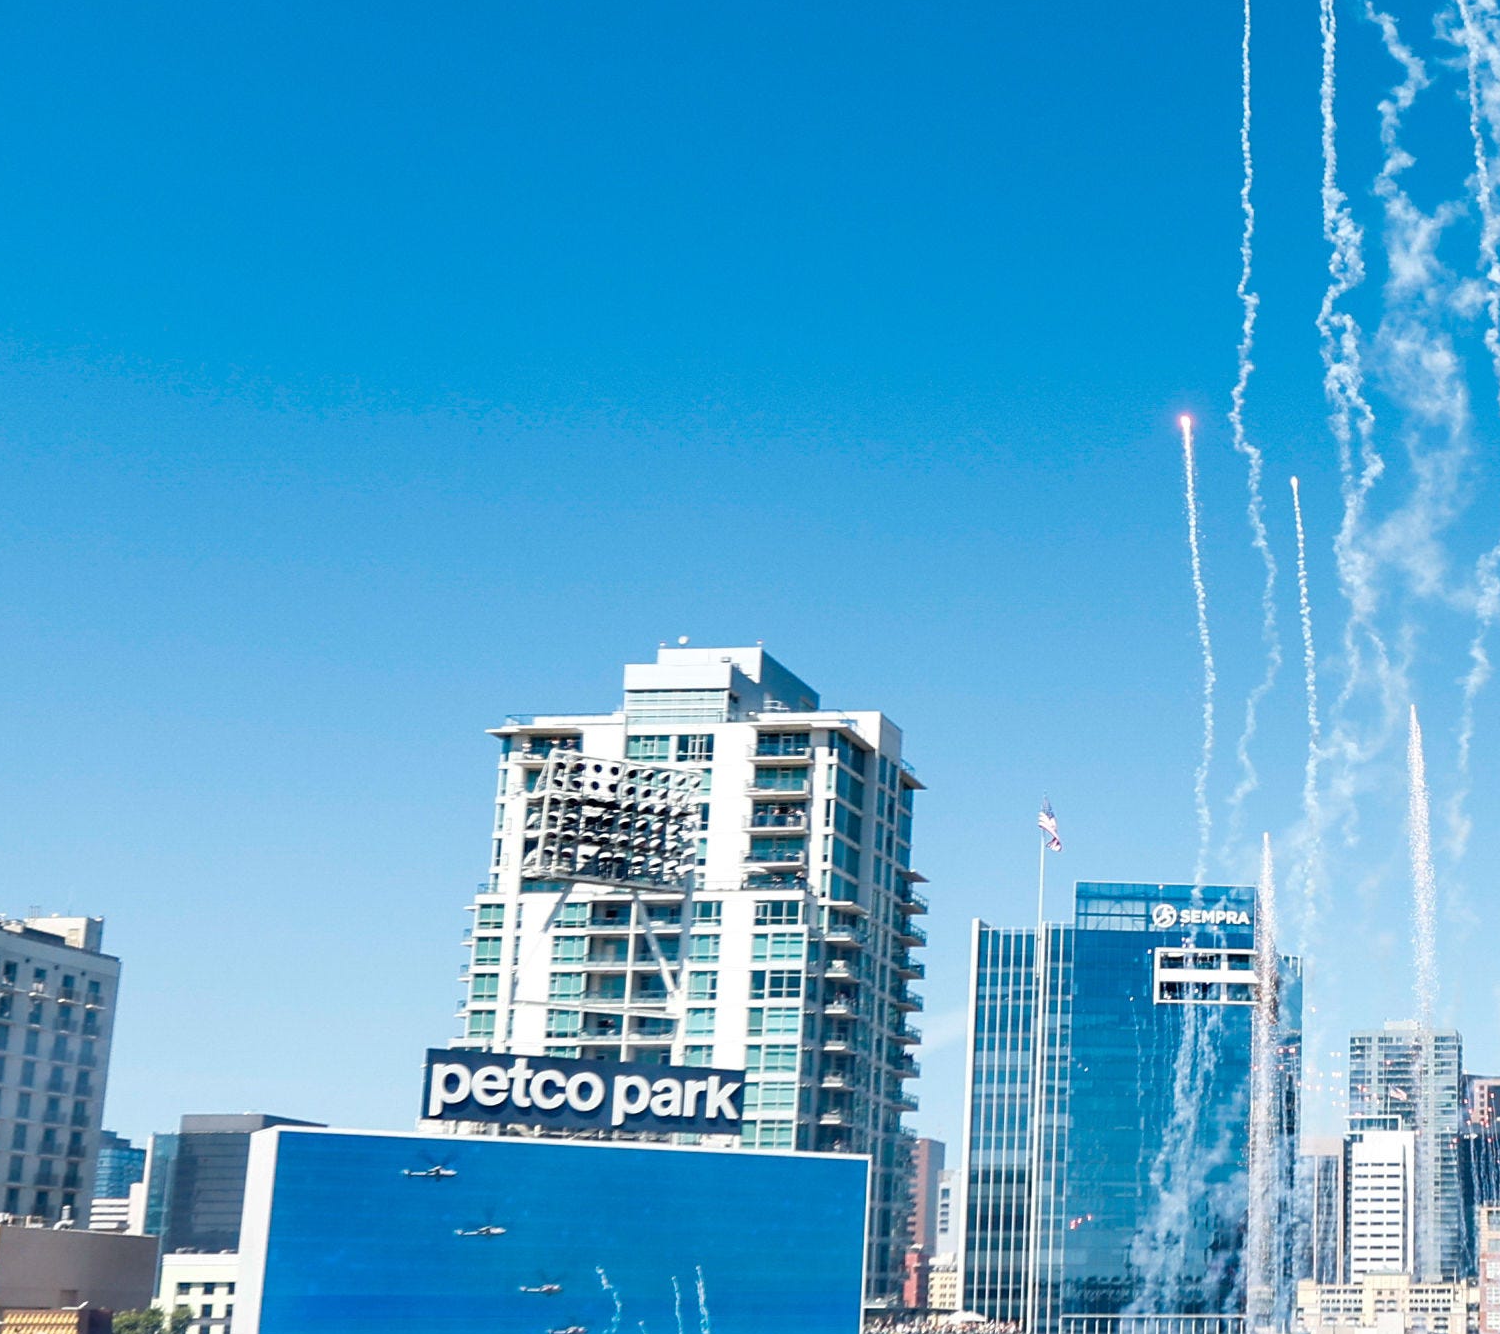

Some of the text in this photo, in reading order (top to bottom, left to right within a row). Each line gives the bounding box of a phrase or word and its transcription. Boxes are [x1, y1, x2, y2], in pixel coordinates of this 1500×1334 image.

[1180, 909, 1250, 925] SEMPRA
[429, 1057, 742, 1126] petco park
